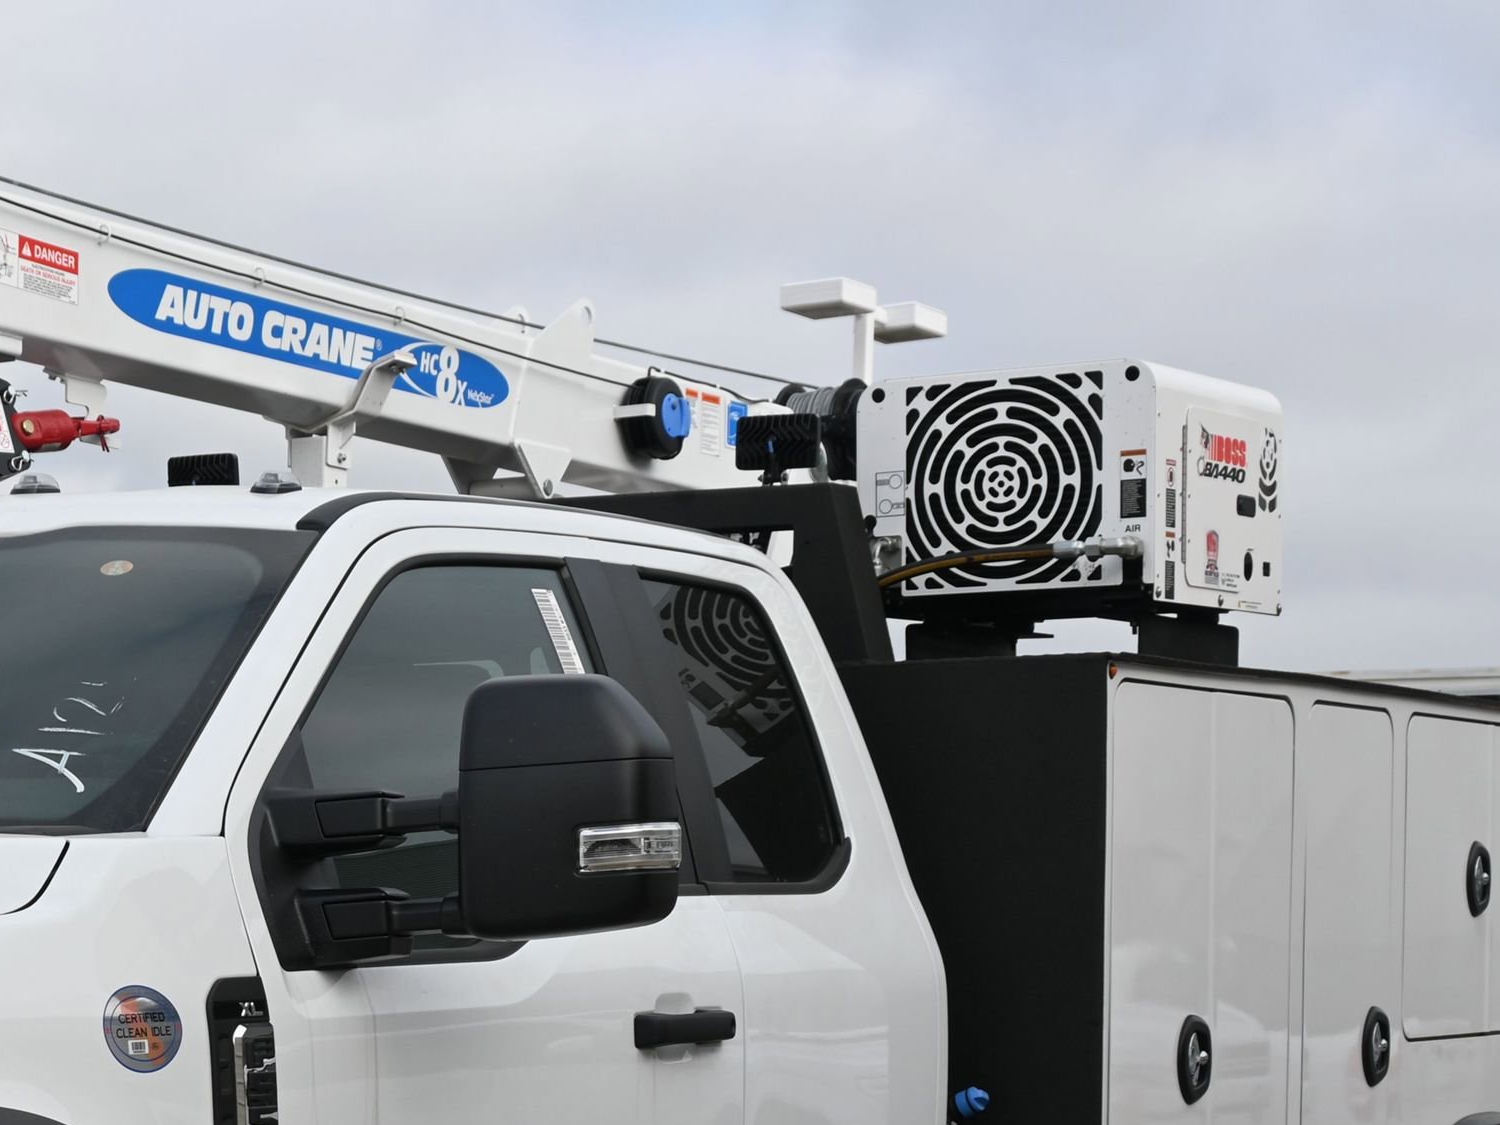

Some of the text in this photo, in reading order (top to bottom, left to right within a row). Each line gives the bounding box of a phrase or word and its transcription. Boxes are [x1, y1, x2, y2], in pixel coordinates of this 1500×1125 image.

[33, 244, 76, 270] DANGER
[154, 283, 376, 370] AUTO CRANE
[1216, 435, 1247, 468] BOSS
[1203, 461, 1246, 484] BA440
[1124, 524, 1141, 533] AIR
[118, 1012, 166, 1024] CERTIFIED
[238, 1001, 264, 1017] XL
[116, 1025, 172, 1039] CLEAN IDLE
